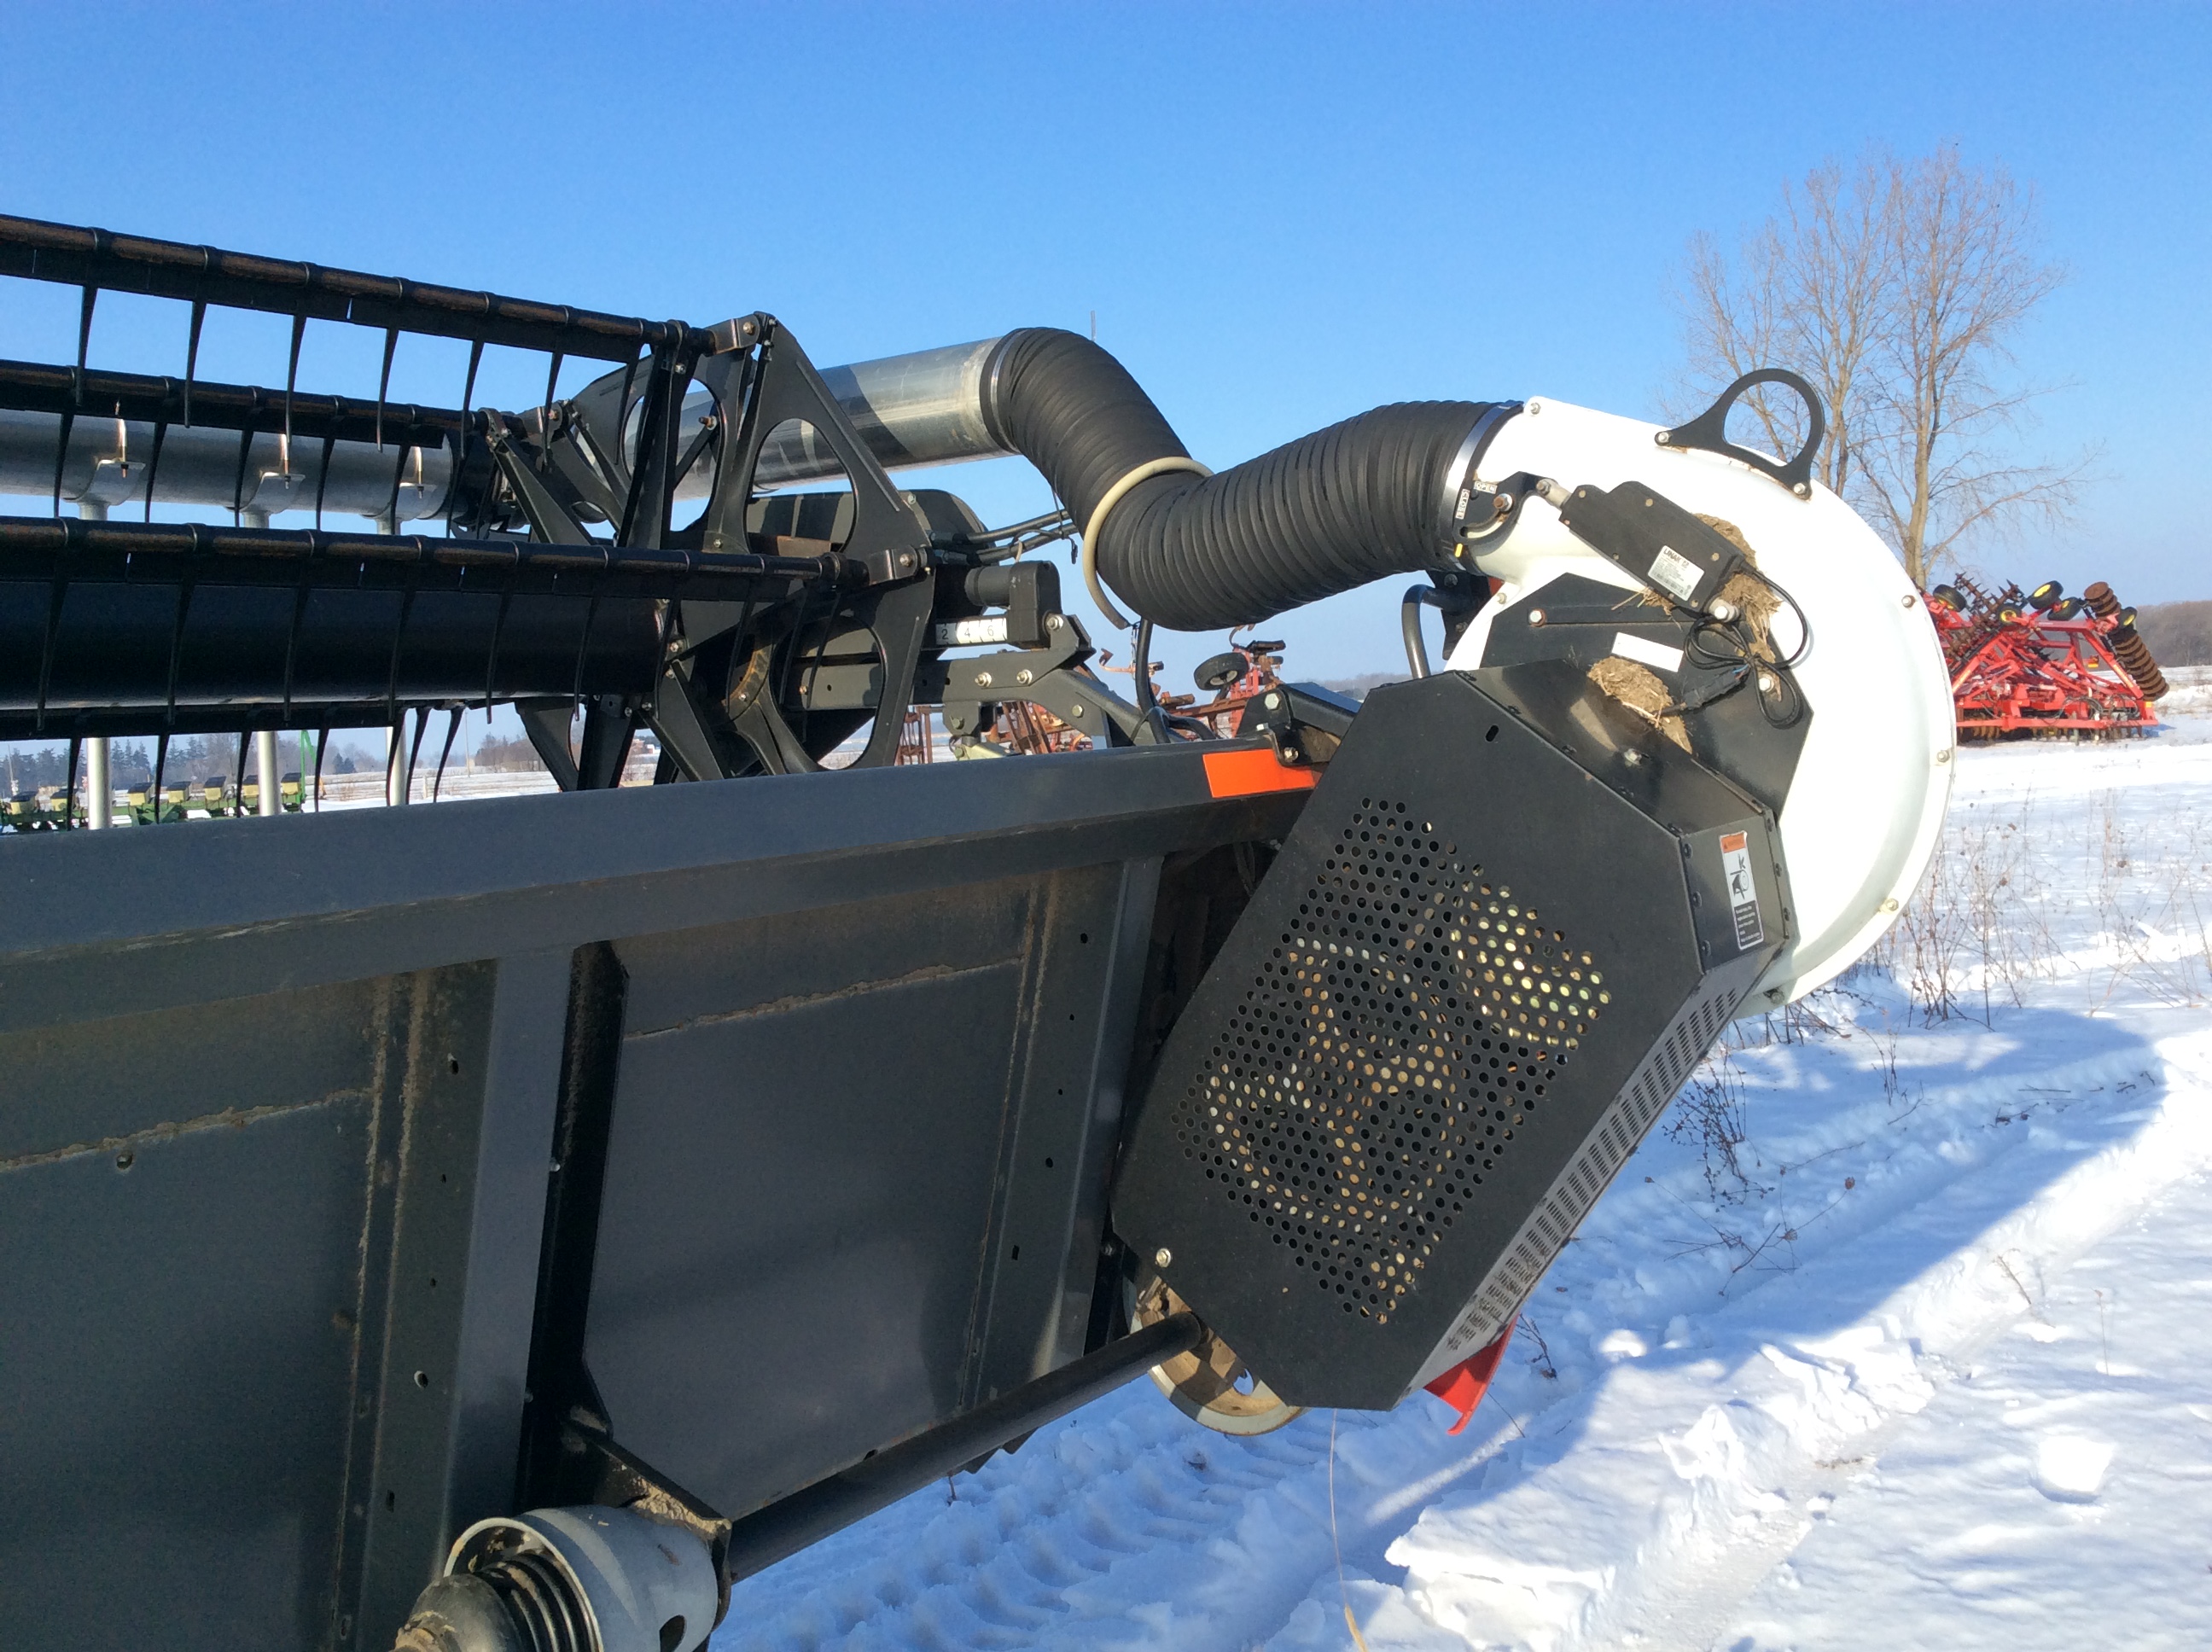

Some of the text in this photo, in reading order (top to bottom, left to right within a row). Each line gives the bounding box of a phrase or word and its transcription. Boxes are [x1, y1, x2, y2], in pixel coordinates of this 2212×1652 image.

[1663, 549, 1681, 563] LINAK
[941, 625, 993, 640] 2 4 6
